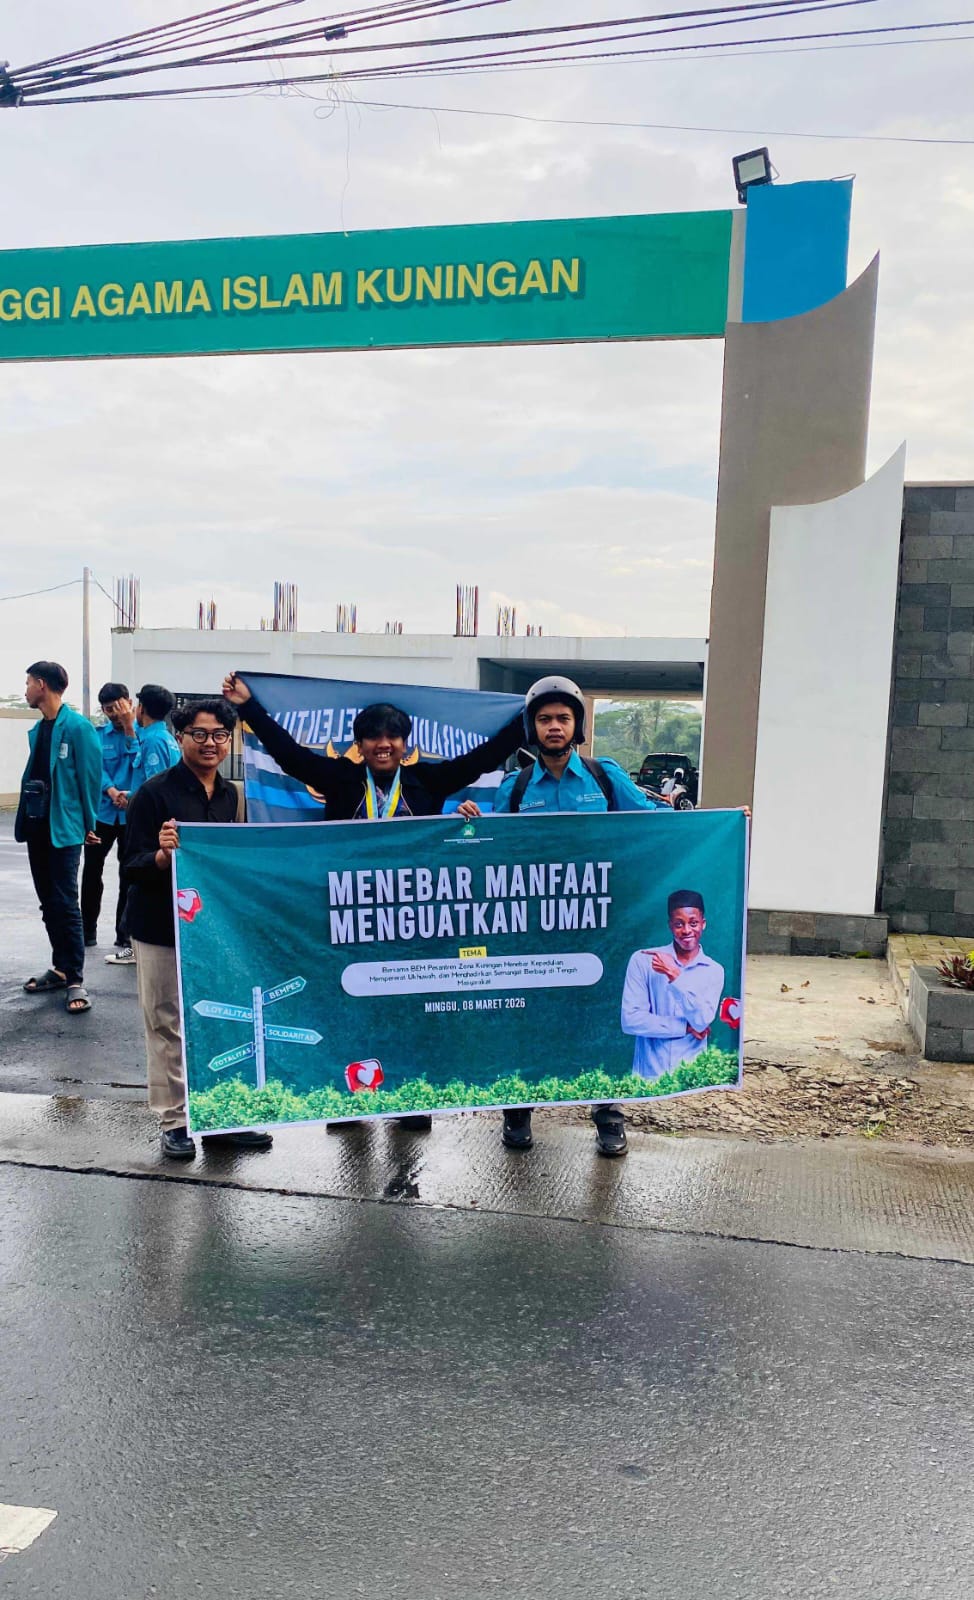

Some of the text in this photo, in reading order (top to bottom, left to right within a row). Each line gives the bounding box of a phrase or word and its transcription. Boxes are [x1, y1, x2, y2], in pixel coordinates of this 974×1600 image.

[71, 280, 211, 319] AGAMA
[221, 272, 343, 310] ISLAM
[356, 259, 580, 304] KUNINGAN
[328, 862, 612, 905] MENEBAR MANFAAT
[330, 898, 612, 944] MENGUATKAN UMAT
[462, 949, 482, 957] TEMA
[269, 981, 301, 999] BEMPES
[206, 1005, 253, 1019] LOYALITAS
[425, 998, 525, 1012] MINGGU, 08 MARET 2026
[269, 1029, 314, 1041] SOLIDARITAS
[214, 1048, 251, 1067] TOTALITAS
